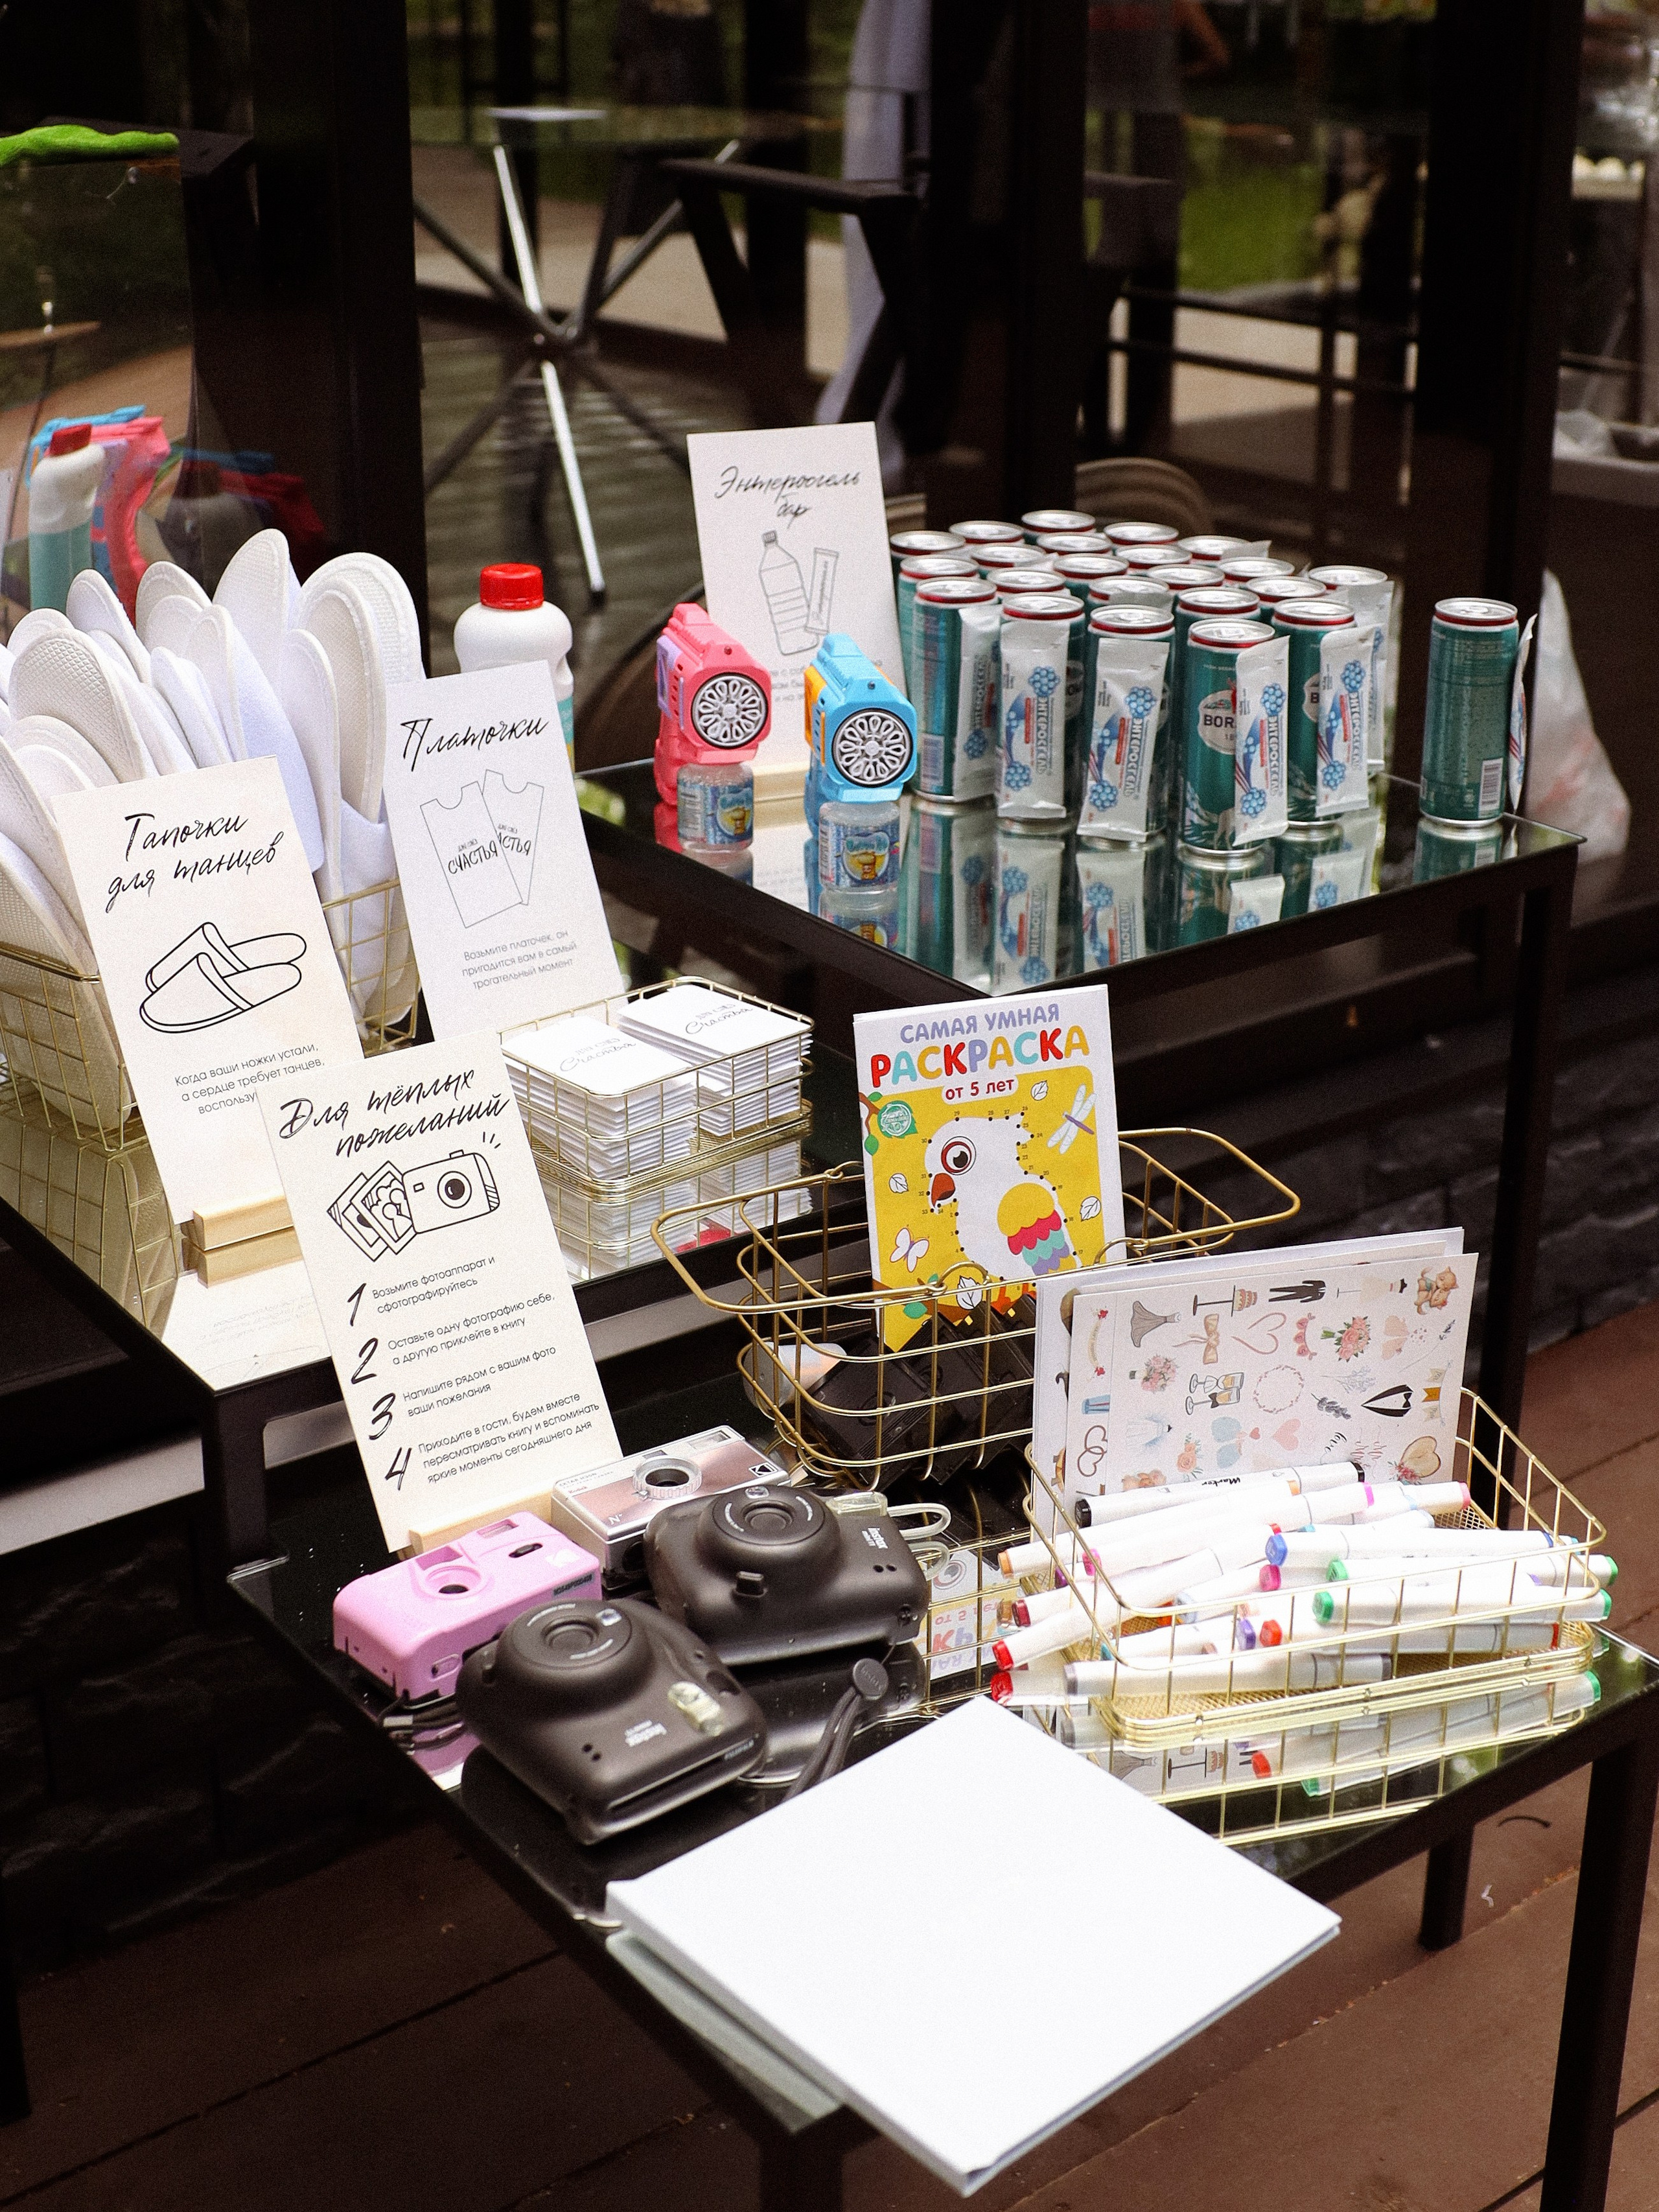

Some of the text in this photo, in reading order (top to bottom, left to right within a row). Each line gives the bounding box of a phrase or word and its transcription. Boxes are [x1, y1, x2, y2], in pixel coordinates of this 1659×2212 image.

[777, 492, 811, 529] бар
[1204, 714, 1236, 729] BOR
[400, 717, 549, 771] Платочки
[124, 813, 249, 861] Тапочки
[448, 841, 498, 874] СЧАСТЬЯ
[106, 832, 284, 913] для танцев
[462, 958, 515, 977] пригодится
[518, 953, 537, 964] вам
[546, 942, 577, 956] самый
[463, 944, 507, 960] Возьмите
[473, 959, 573, 990] трогательный момент
[900, 1003, 1060, 1043] САМАЯ УМНАЯ
[175, 1044, 319, 1086] Когда ваши ножки устали,
[870, 1025, 1089, 1088] РАСКРАСКА
[181, 1058, 325, 1102] а сердце требует танцев,
[945, 1078, 1015, 1100] от 5 лет
[198, 1091, 257, 1114] воспользу
[279, 1069, 474, 1139] Для тёплых
[336, 1093, 511, 1158] пожеланий
[373, 1279, 419, 1299] Возьмите
[421, 1259, 486, 1286] фотоаппарат
[377, 1277, 478, 1314] сфотографируйтесь
[347, 1283, 367, 1327] 1
[388, 1292, 555, 1350] Оставьте одну фотографию себе,
[351, 1338, 378, 1384] 2
[393, 1356, 400, 1365] а
[402, 1345, 439, 1364] другую
[441, 1327, 491, 1351] приклейте
[501, 1317, 526, 1331] книгу
[403, 1346, 556, 1402] Напишите рядом с вашим фото
[369, 1393, 396, 1441] 3
[408, 1384, 491, 1417] ваши пожелания
[419, 1430, 472, 1454] Приходите
[481, 1419, 511, 1432] гости,
[512, 1405, 544, 1422] будем
[546, 1393, 580, 1411] вместе
[423, 1436, 506, 1469] пересматривать
[507, 1425, 533, 1440] книгу
[543, 1403, 599, 1428] вспоминать
[1324, 1432, 1347, 1454] love
[385, 1447, 412, 1491] 4
[427, 1421, 592, 1484] яркие моменты сегодняшнего дня
[1201, 1477, 1240, 1487] Marker
